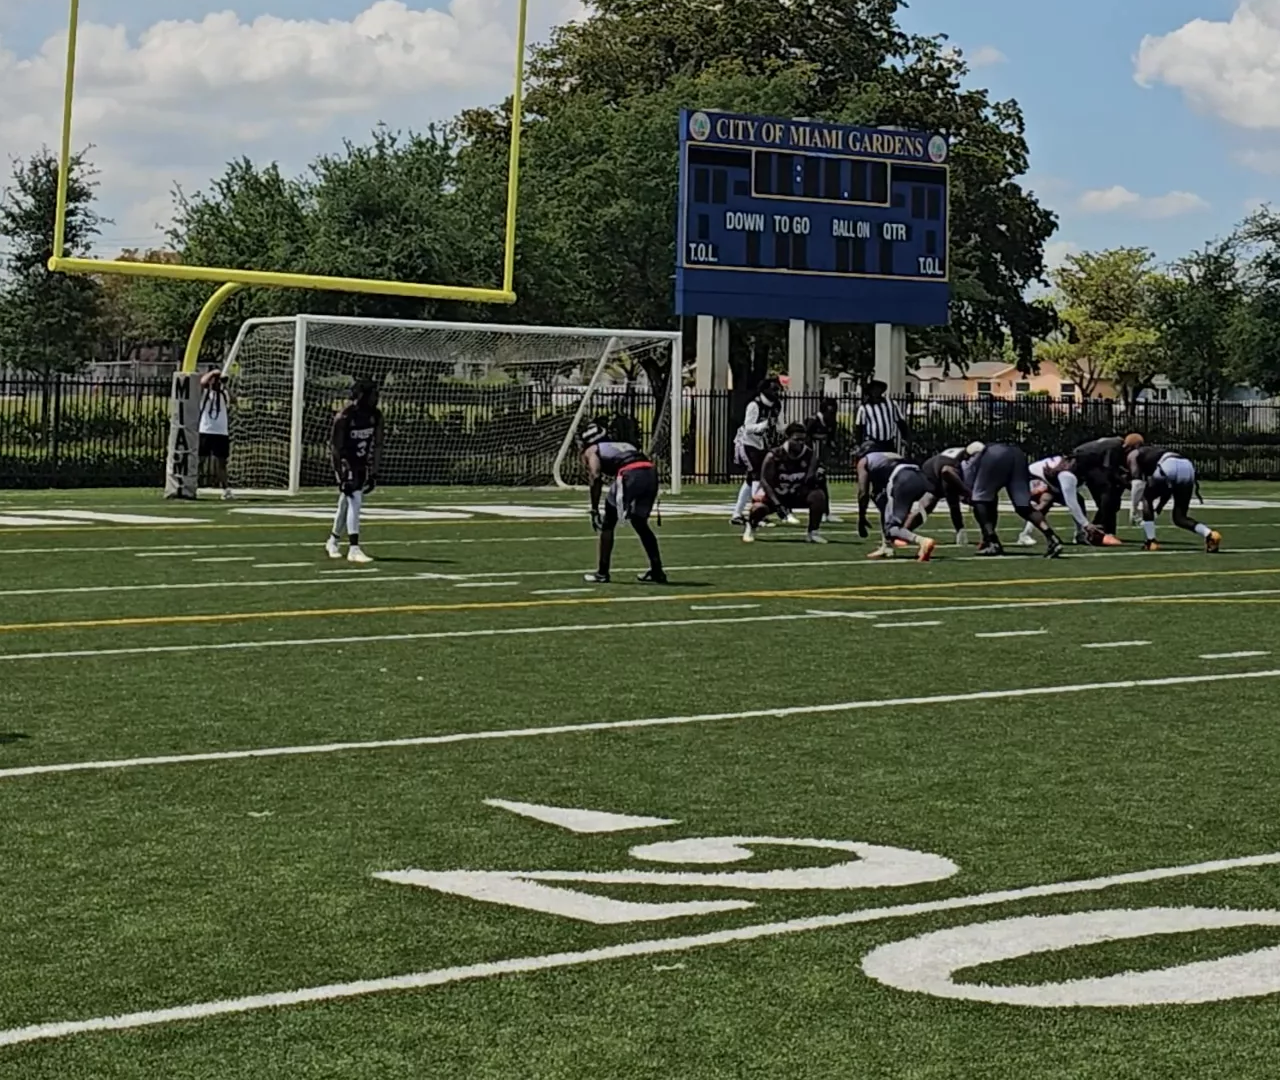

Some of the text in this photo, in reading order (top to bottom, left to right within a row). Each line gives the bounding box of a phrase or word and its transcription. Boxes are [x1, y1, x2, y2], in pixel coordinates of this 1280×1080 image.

[716, 118, 923, 158] CITY OF MIAMI GARDENS
[726, 211, 764, 232] DOWN
[773, 215, 810, 234] TO GO
[832, 219, 870, 238] BALL ON
[882, 222, 907, 240] QTR
[172, 375, 190, 499] MIAMI
